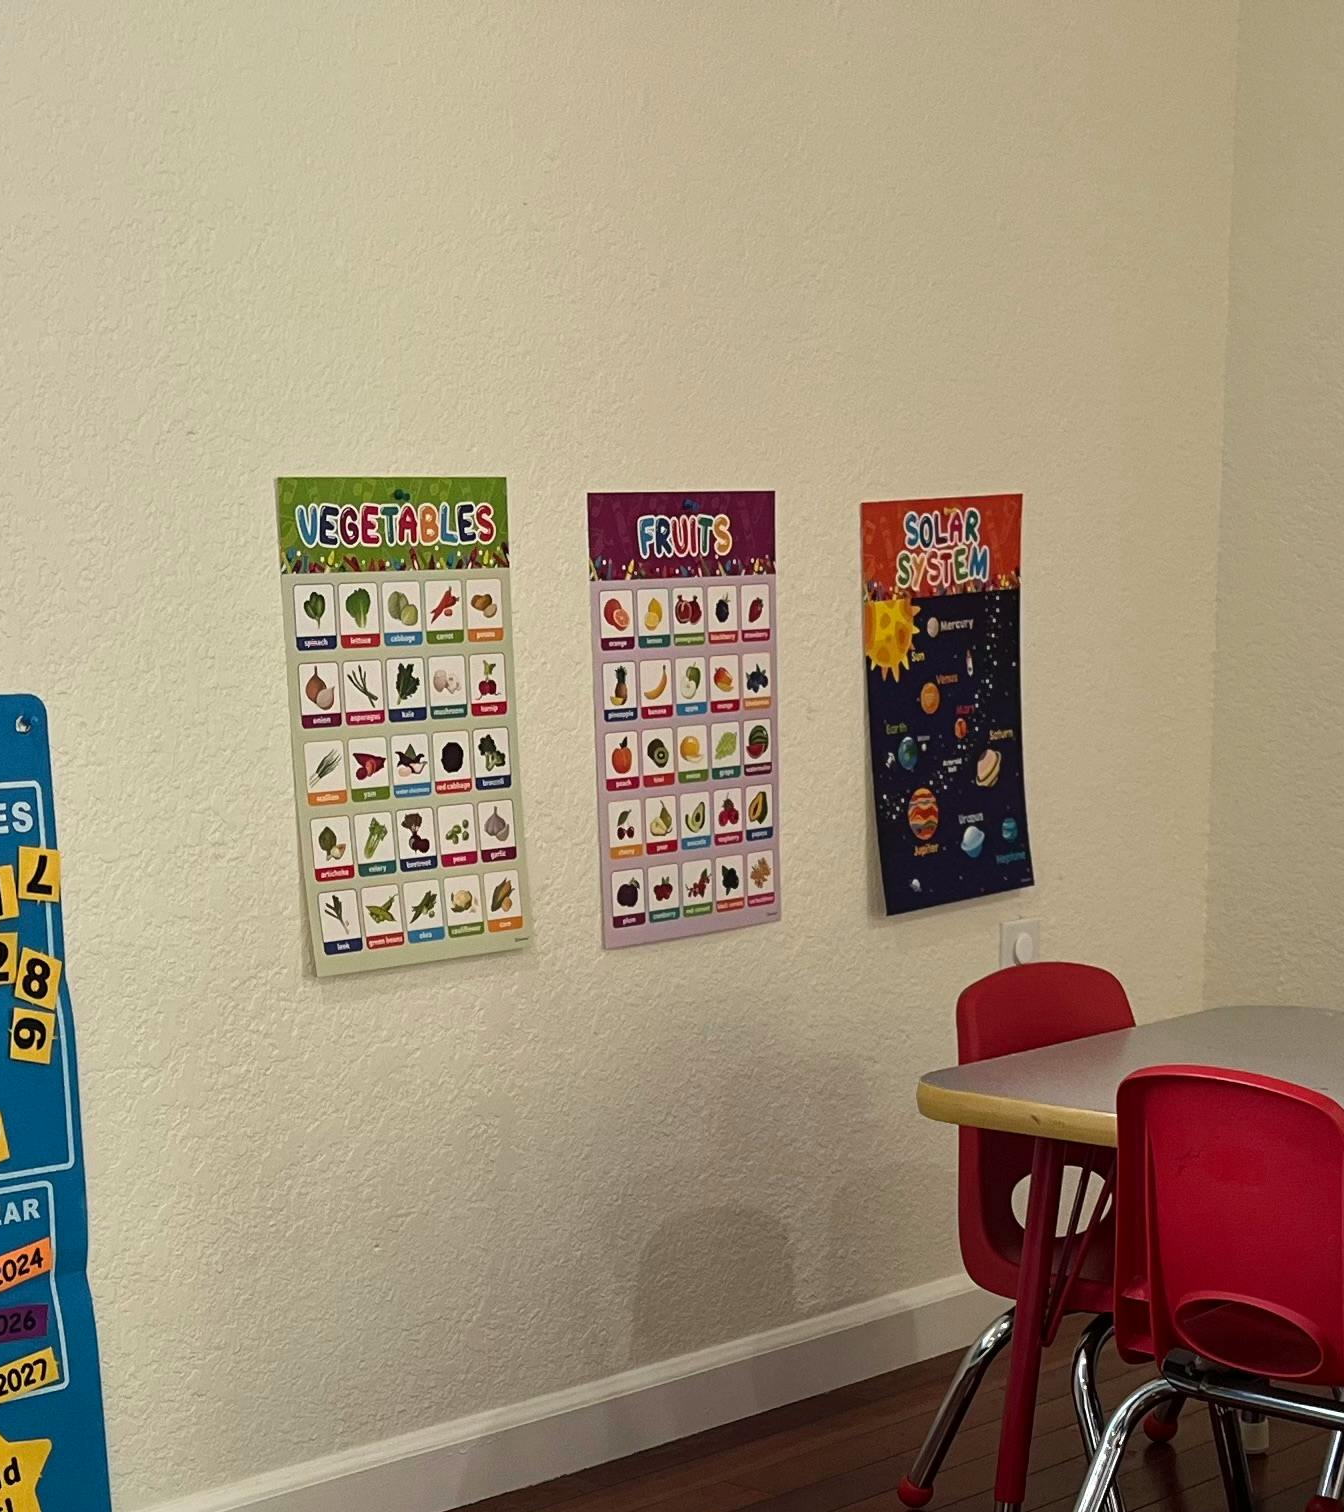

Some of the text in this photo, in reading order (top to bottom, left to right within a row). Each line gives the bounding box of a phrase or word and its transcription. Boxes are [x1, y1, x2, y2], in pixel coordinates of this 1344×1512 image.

[295, 501, 496, 548] VEGETABLES
[637, 514, 733, 559] FRUITS
[904, 506, 981, 551] SOLAR
[896, 543, 990, 592] SYSTEM
[305, 638, 328, 648] spinach
[940, 618, 974, 632] Mercury
[911, 651, 925, 662] Sun
[885, 722, 908, 736] Earth
[26, 855, 53, 895] 7
[22, 958, 50, 999] 8
